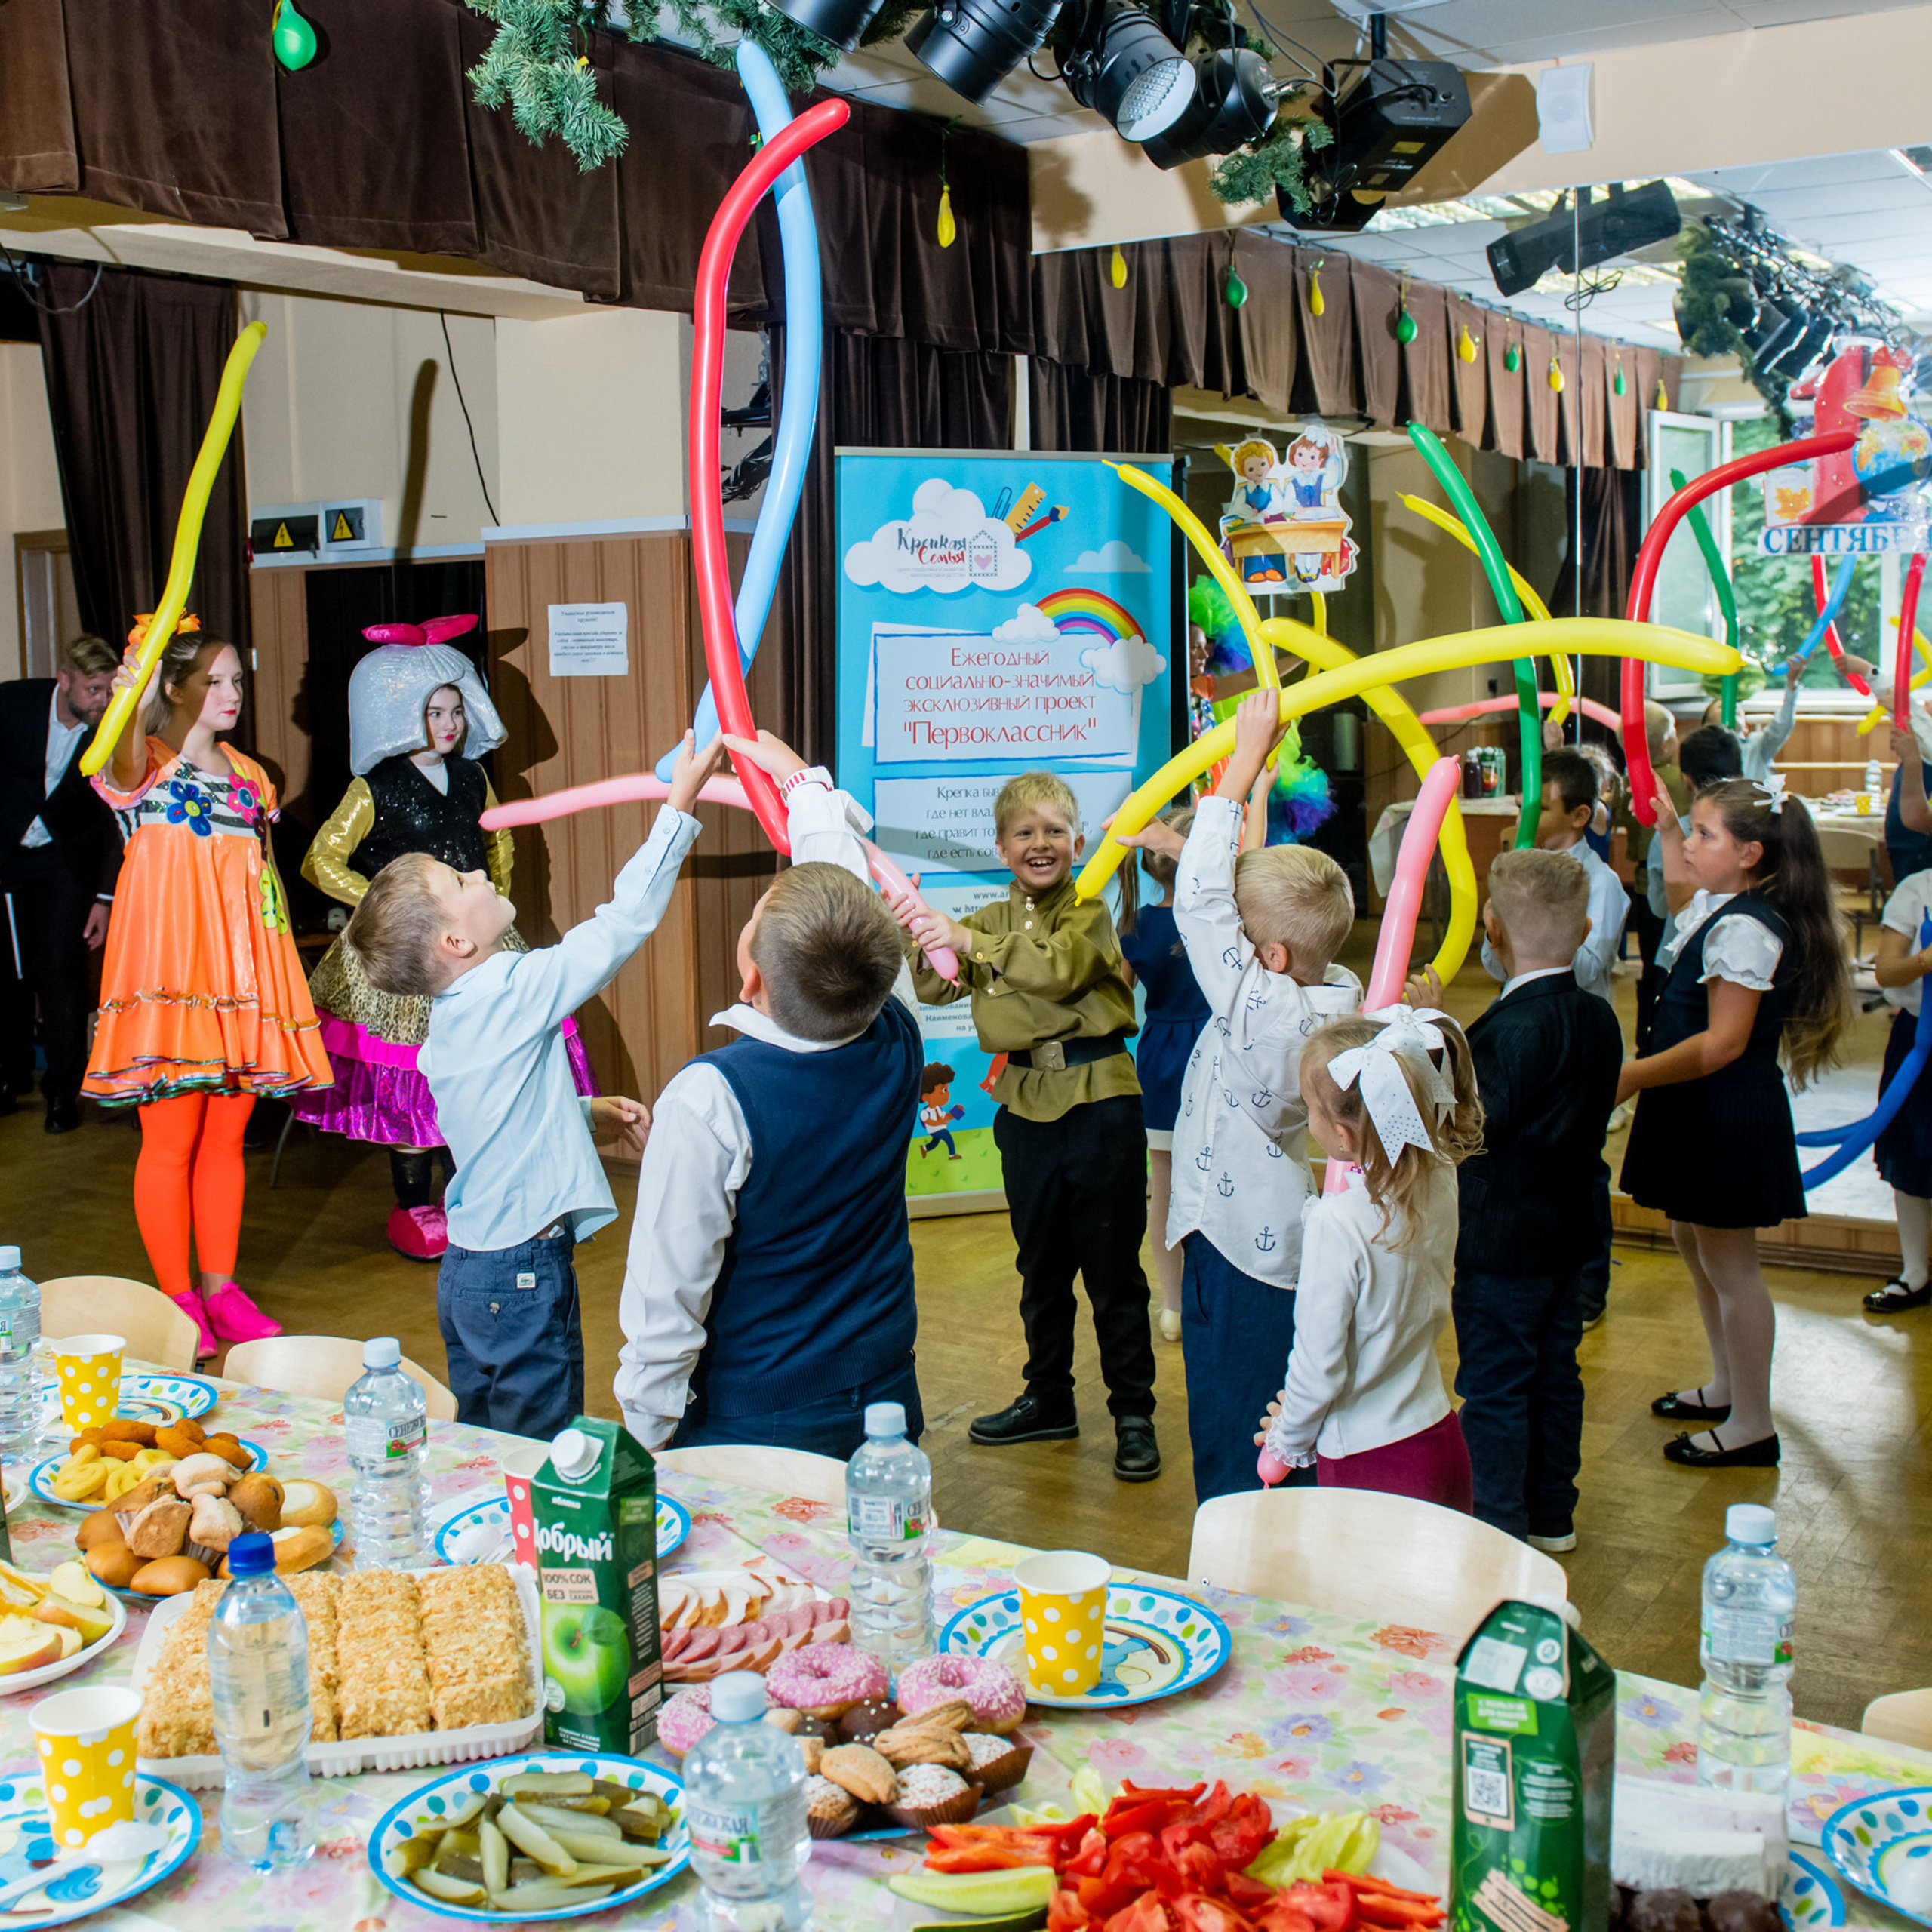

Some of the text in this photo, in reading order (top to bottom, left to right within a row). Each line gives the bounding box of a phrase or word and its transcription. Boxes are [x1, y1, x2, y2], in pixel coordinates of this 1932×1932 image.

[897, 528, 966, 555] Крепкая
[918, 546, 965, 565] Семья
[952, 648, 1050, 666] Ежегодный
[906, 671, 1094, 691] социально-значимый
[903, 694, 1097, 715] эксклюзивный проект
[903, 718, 1097, 749] "Первоклассник"
[937, 786, 1001, 801] Крепка быв
[926, 809, 946, 819] где
[949, 808, 968, 818] нет
[915, 830, 936, 839] где
[939, 828, 977, 841] правит
[928, 848, 947, 859] где
[950, 848, 974, 858] есть
[543, 1574, 592, 1584] 100% СОК
[547, 1589, 565, 1599] БЕЗ
